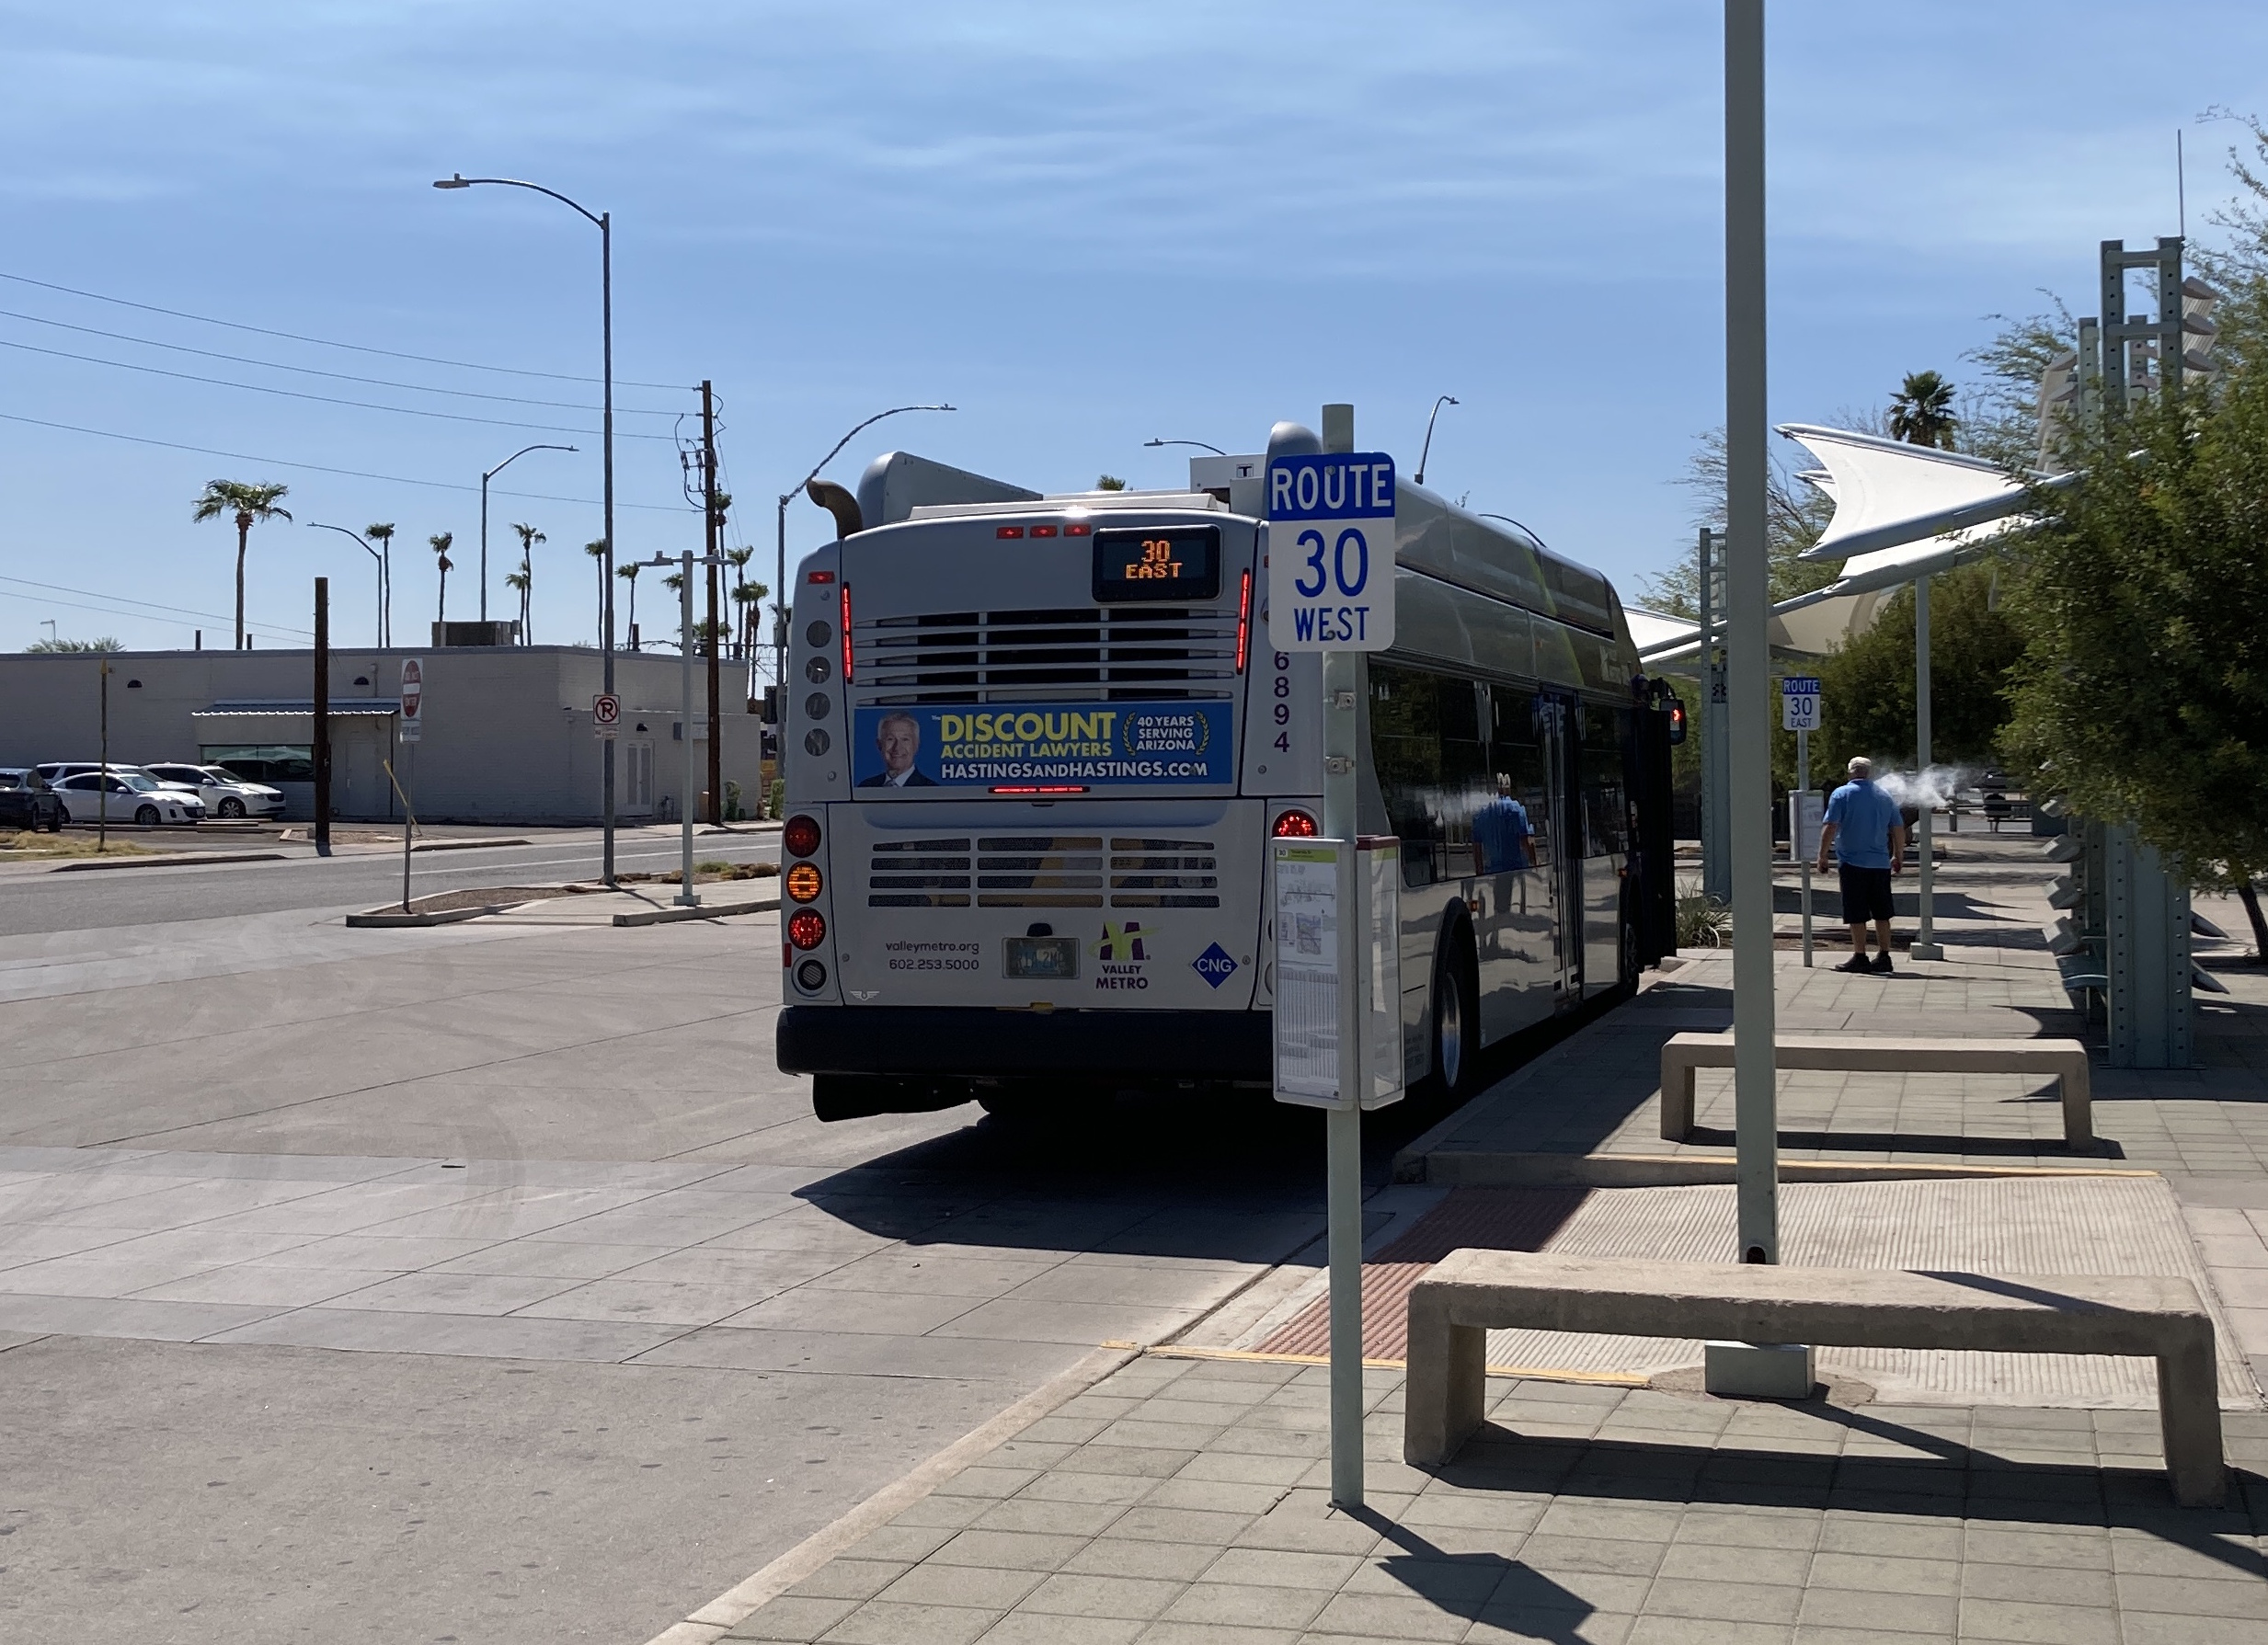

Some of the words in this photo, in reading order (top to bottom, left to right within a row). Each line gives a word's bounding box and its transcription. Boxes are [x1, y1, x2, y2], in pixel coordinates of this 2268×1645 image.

[1271, 463, 1392, 511] ROUTE
[1140, 540, 1170, 562] 30
[1295, 528, 1369, 598] 30
[1126, 563, 1183, 579] EAST
[1293, 607, 1369, 642] WEST
[1783, 680, 1820, 693] ROUTE
[1274, 651, 1289, 753] 6894
[1790, 697, 1813, 715] 30
[941, 712, 1117, 742] DISCOUNT
[1137, 716, 1153, 726] 40
[1155, 716, 1195, 726] YEARS
[1791, 717, 1812, 728] EAST
[1138, 728, 1194, 738] SERVING
[941, 743, 1025, 759] ACCIDENT
[1029, 742, 1113, 758] LAWYERS
[1136, 740, 1196, 750] ARIZONA
[941, 761, 1208, 779] HASTINGSANDHASTINGS.COM
[886, 941, 979, 954] valleymetro.org
[889, 959, 979, 970] 602.253.5000
[1102, 965, 1142, 975] VALLEY
[1197, 958, 1232, 973] CNG
[1095, 977, 1149, 989] METRO
